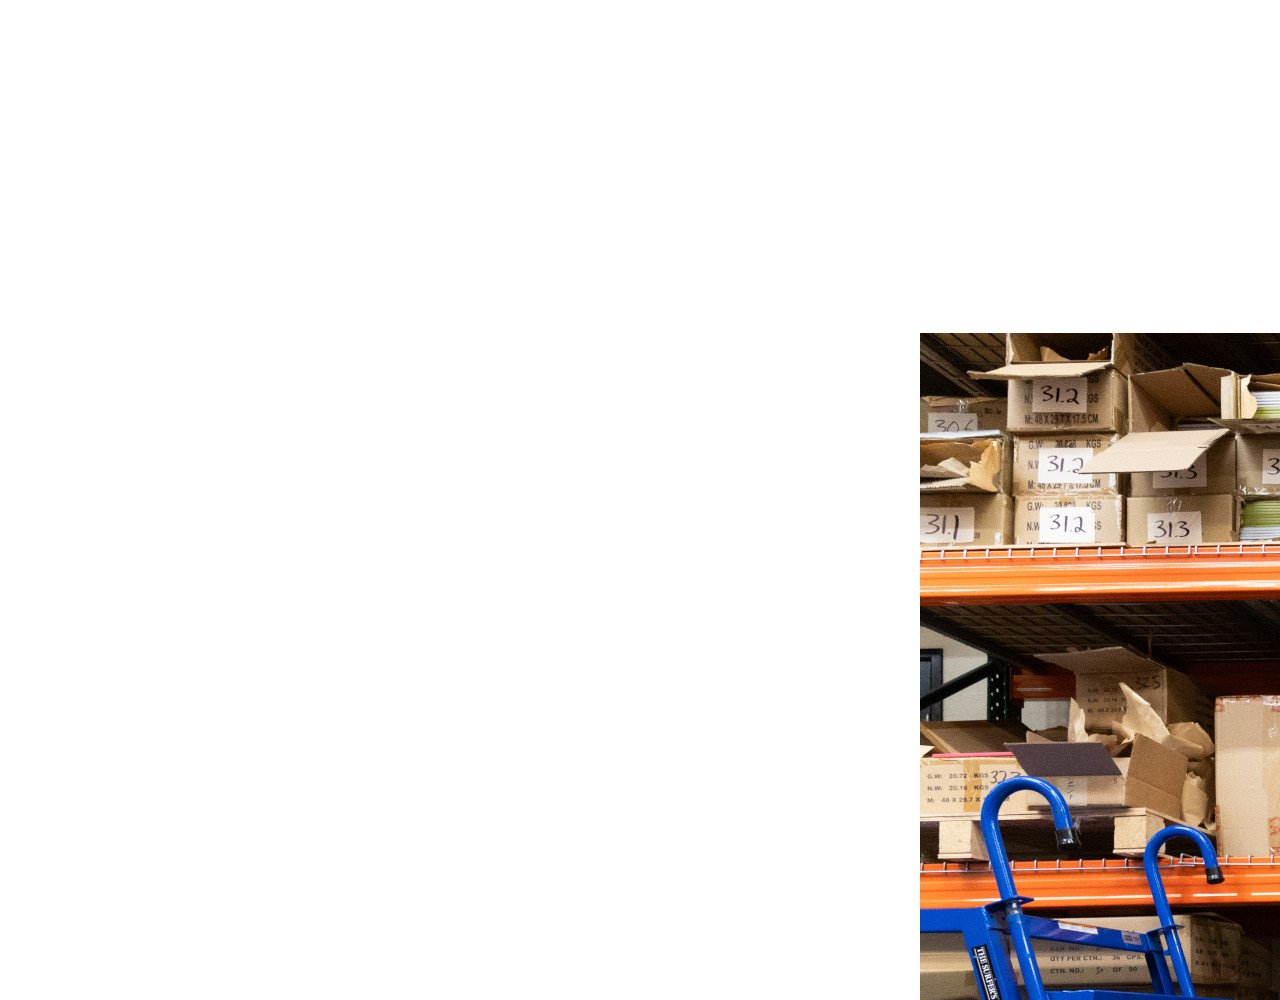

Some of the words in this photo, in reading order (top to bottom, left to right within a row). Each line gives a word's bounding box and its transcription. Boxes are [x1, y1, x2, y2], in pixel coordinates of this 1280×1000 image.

[1040, 385, 1080, 405] 31.2
[1088, 414, 1099, 423] CM
[1086, 440, 1102, 448] KGS
[1047, 455, 1084, 474] 31.2
[1086, 501, 1102, 510] KGS
[1049, 514, 1087, 533] 31.2
[1154, 520, 1190, 538] 31.3
[977, 946, 987, 965] THE
[982, 964, 998, 1000] SURFER'S
